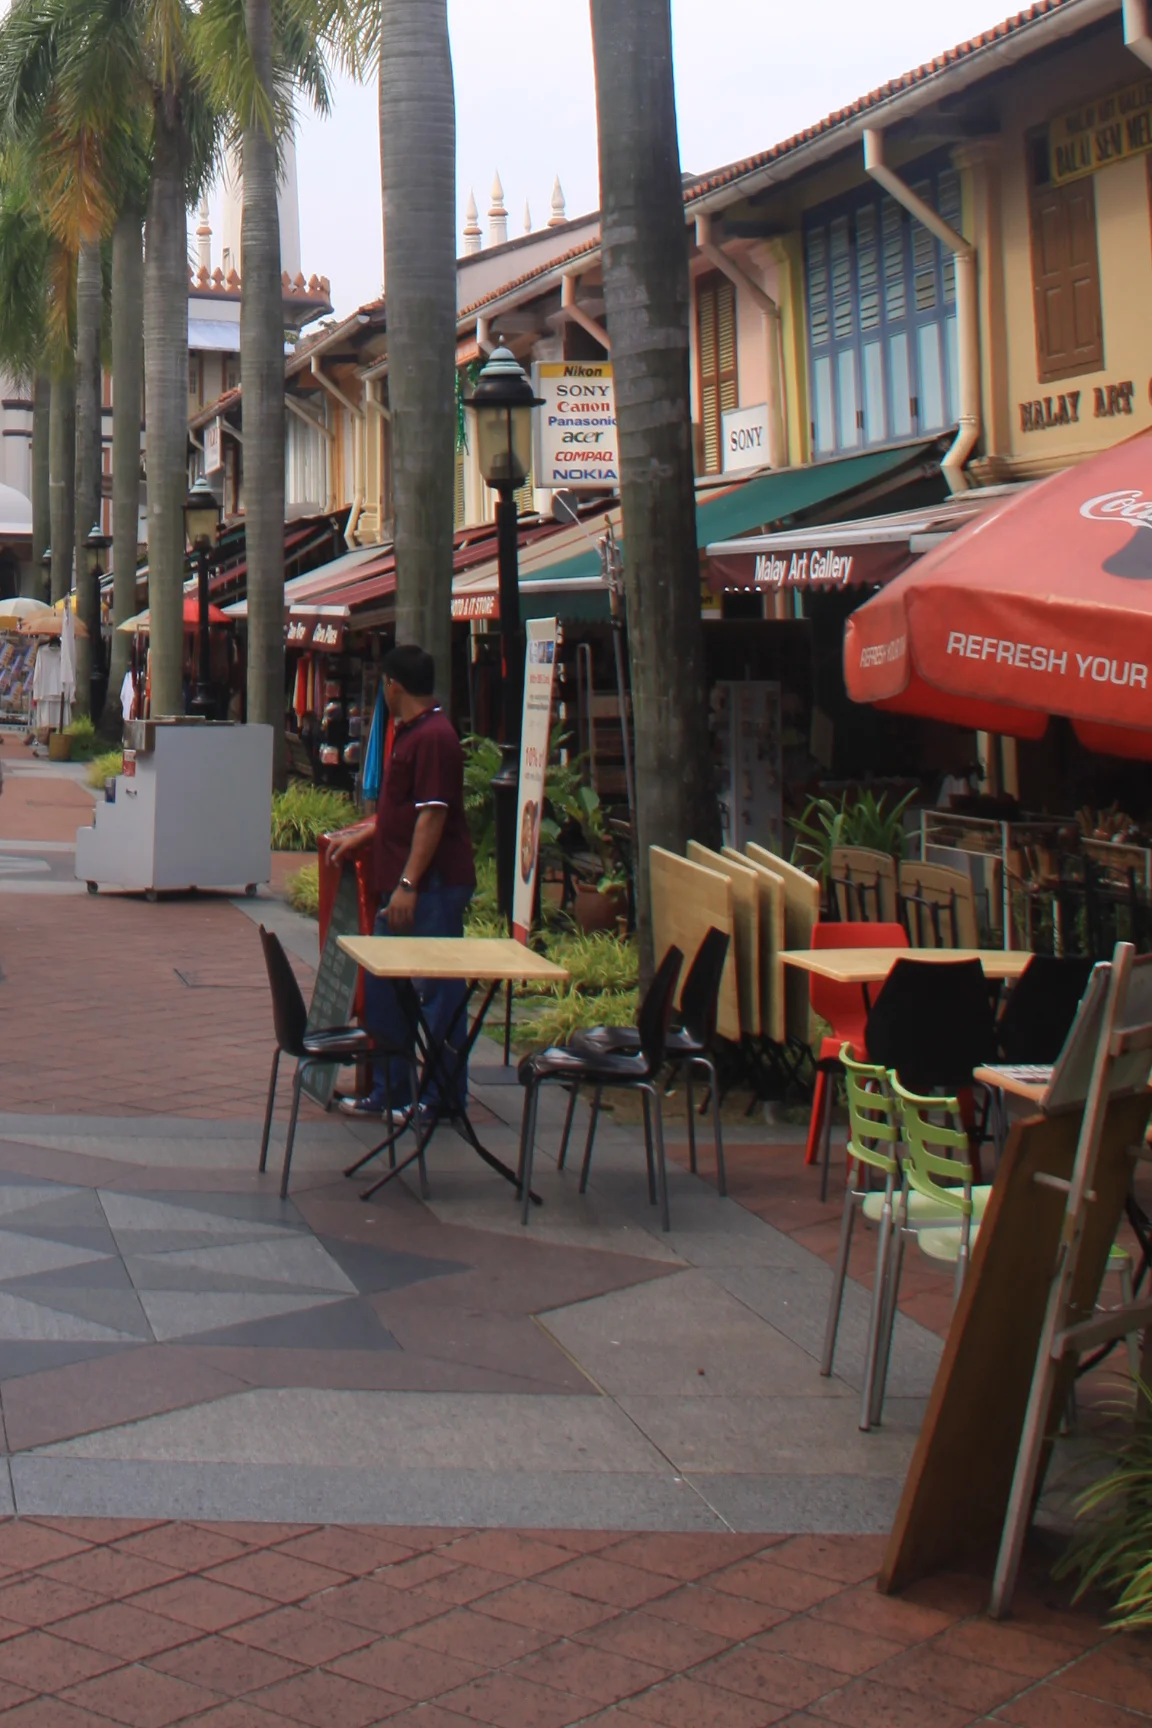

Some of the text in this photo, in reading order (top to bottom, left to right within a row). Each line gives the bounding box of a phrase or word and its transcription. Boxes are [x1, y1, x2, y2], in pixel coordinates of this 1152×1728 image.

[1055, 134, 1092, 178] BALAI
[563, 365, 602, 377] Nikon
[556, 384, 610, 397] SONY
[556, 400, 611, 413] Canon
[1019, 380, 1135, 434] MALAY ART
[561, 431, 604, 443] acer
[730, 425, 763, 452] SONY
[554, 450, 614, 462] COMPAQ
[552, 468, 618, 480] NOKIA
[754, 549, 854, 587] Malay Art Gallery
[476, 595, 495, 615] STORE
[859, 644, 887, 668] REFRESH
[946, 630, 1149, 689] REFRESH YOUR
